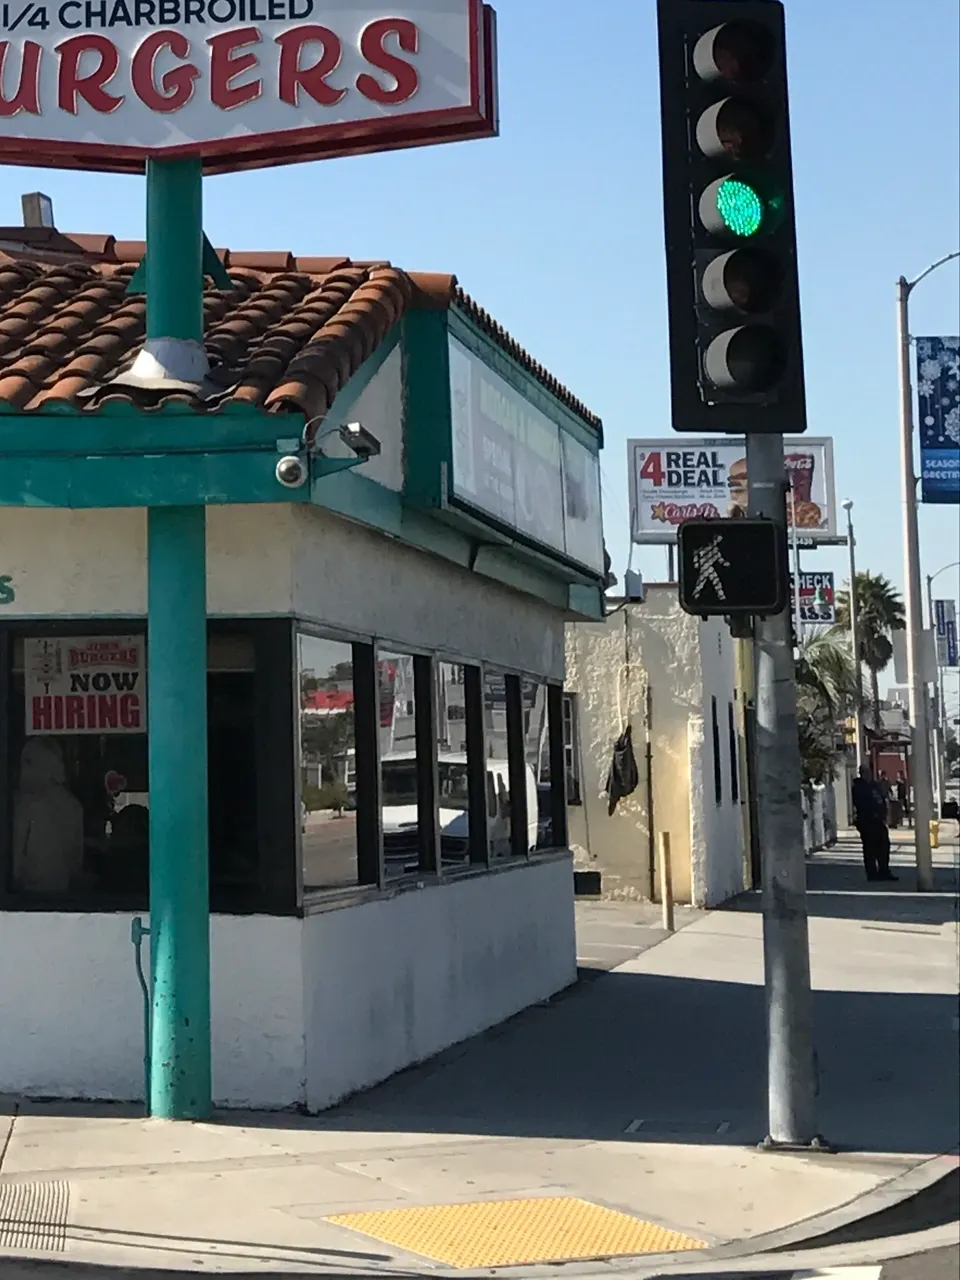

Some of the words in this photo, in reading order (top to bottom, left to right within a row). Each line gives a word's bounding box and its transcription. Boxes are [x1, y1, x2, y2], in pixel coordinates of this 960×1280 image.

[2, 1, 50, 32] 1/4
[666, 451, 725, 469] REAL
[667, 470, 726, 487] DEAL
[70, 672, 139, 692] NOW
[32, 693, 141, 730] HIRING
